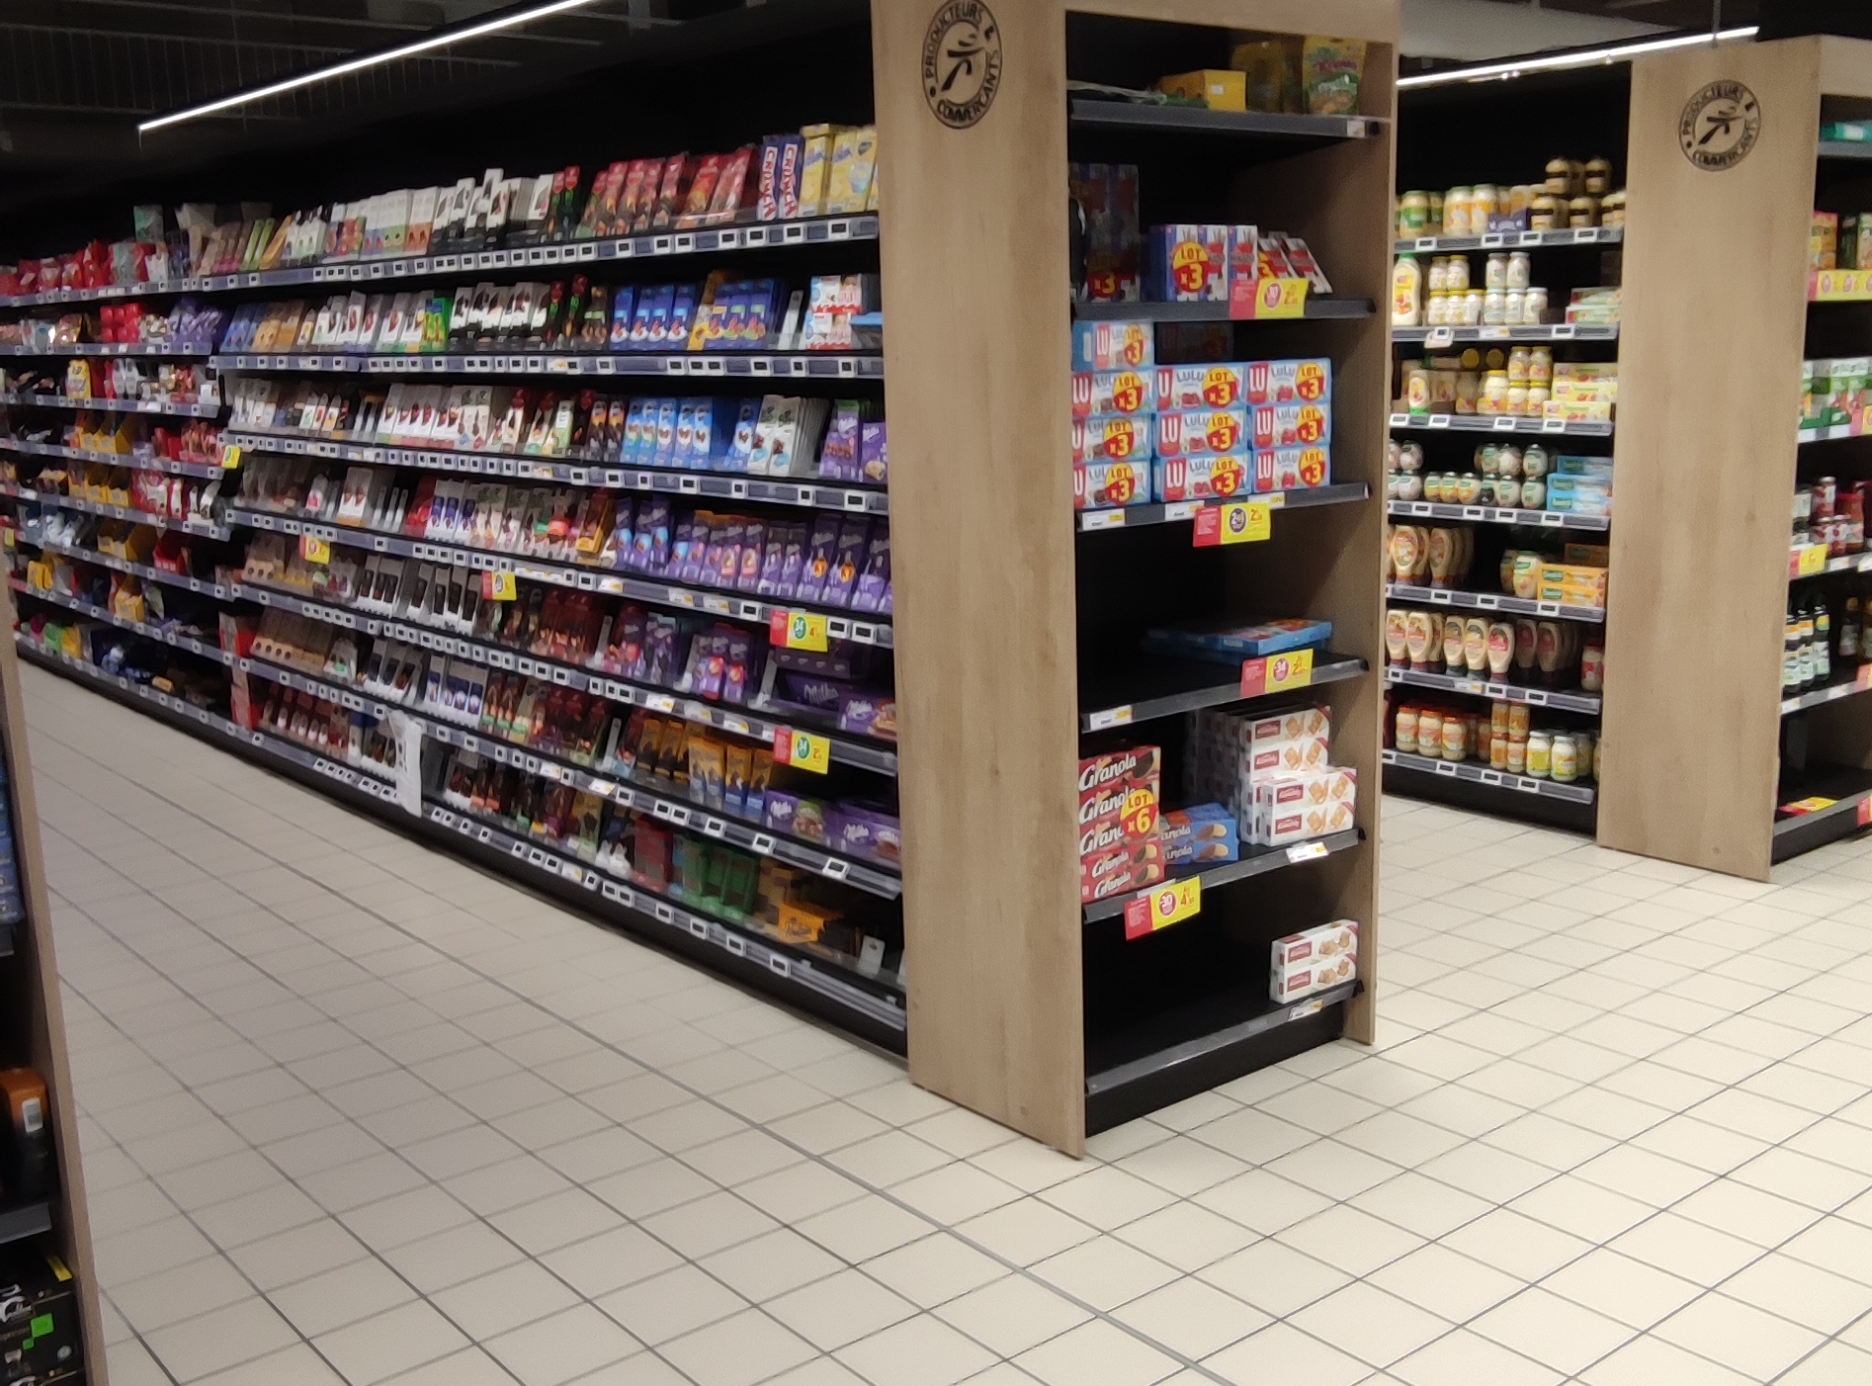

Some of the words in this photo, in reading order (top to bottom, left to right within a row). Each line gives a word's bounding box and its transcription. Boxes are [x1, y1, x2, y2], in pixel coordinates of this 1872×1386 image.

[925, 0, 984, 80] PRODUCTEURS
[764, 149, 777, 219] CRUNCH
[784, 147, 797, 217] CRUNCH
[1180, 247, 1201, 260] LOT
[1180, 263, 1203, 290] x3
[1097, 329, 1109, 355] LU
[1120, 376, 1135, 387] LOT
[1210, 373, 1227, 382] LOT
[1249, 367, 1266, 392] LU
[1271, 365, 1296, 376] LULU
[1302, 366, 1318, 376] LOT
[1073, 377, 1090, 404] LU
[1158, 372, 1170, 397] U
[1210, 383, 1231, 405] x3
[1302, 378, 1319, 399] x3
[1119, 388, 1138, 411] x3
[1212, 416, 1229, 426] LOT
[1257, 410, 1271, 436] LU
[1301, 409, 1316, 419] LOT
[1072, 422, 1082, 449] U
[1110, 422, 1127, 433] LOT
[1161, 416, 1179, 443] LU
[1301, 421, 1318, 442] x3
[1109, 434, 1129, 456] x3
[1212, 428, 1232, 450] x3
[1216, 461, 1233, 471] LOT
[1258, 455, 1271, 480] LU
[1304, 454, 1319, 463] LOT
[1074, 469, 1084, 496] U
[1111, 467, 1128, 478] LOT
[1166, 461, 1183, 488] LU
[1216, 472, 1235, 493] x3
[1305, 464, 1321, 484] x3
[1111, 479, 1130, 502] x3
[803, 683, 840, 705] Milka
[1078, 753, 1138, 794] Granola
[770, 799, 792, 819] Milka
[1078, 787, 1136, 826] Granol
[1128, 794, 1149, 809] LOT
[1127, 808, 1151, 834] x6
[843, 824, 870, 842] Milka
[1092, 851, 1130, 879] Granola
[1094, 870, 1132, 899] Granola
